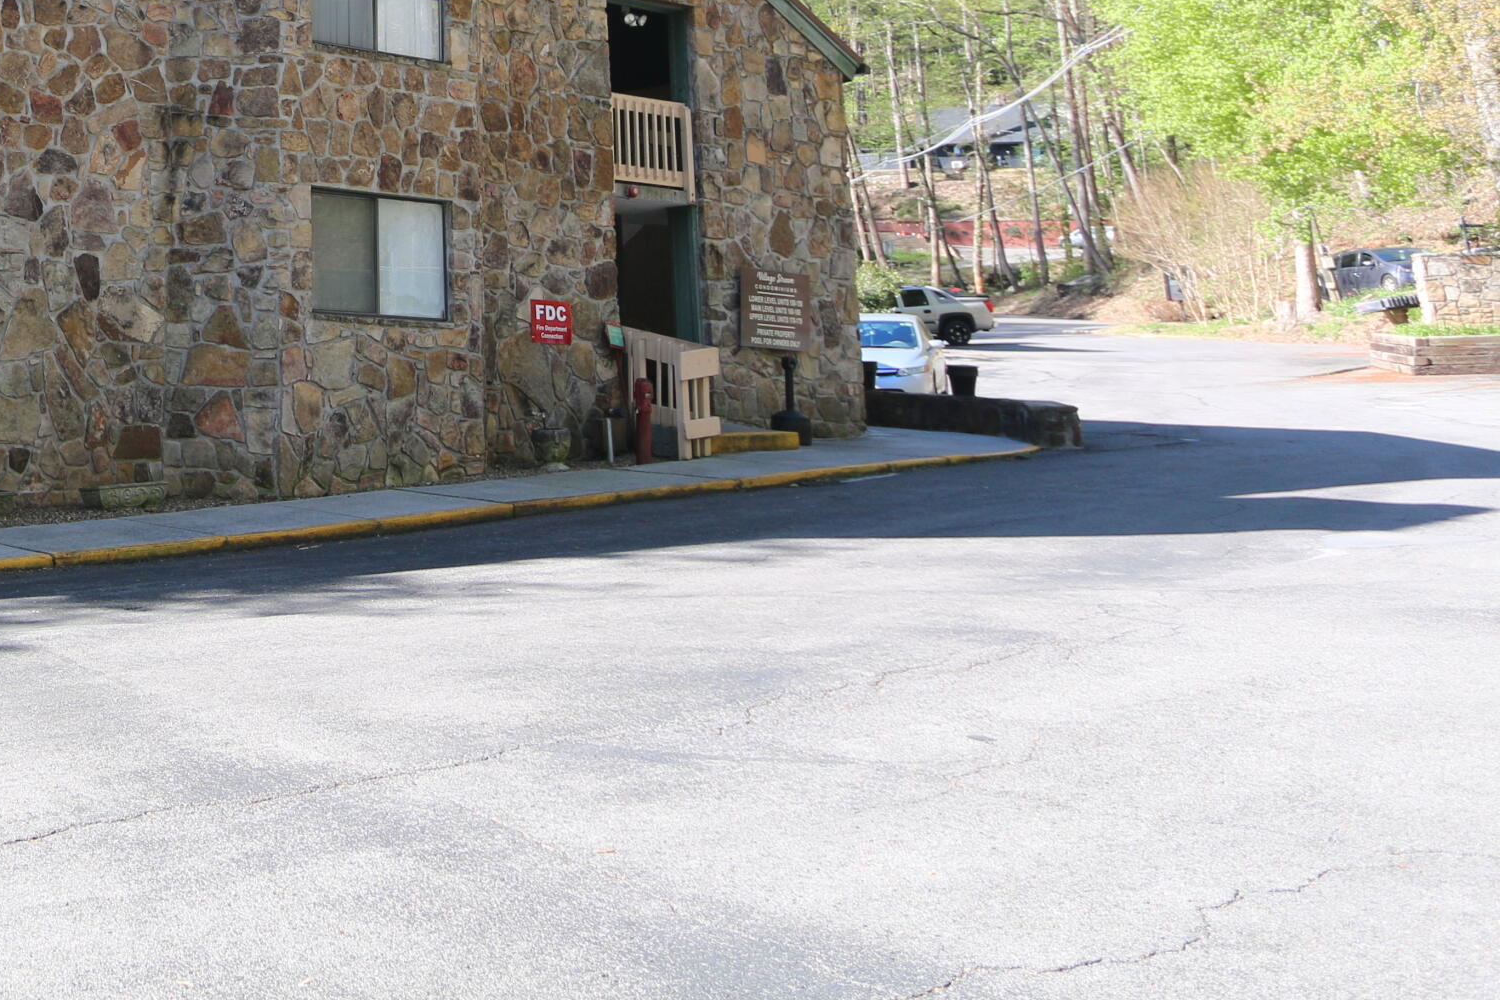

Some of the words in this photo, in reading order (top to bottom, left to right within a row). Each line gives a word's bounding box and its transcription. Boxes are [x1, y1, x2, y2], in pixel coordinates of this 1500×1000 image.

[757, 271, 776, 285] Village
[749, 295, 764, 303] LOWER
[764, 296, 777, 304] LEVEL
[535, 304, 567, 322] FDC
[751, 304, 762, 312] MAIN
[762, 305, 774, 313] LEVEL
[763, 314, 776, 322] LEVEL
[545, 324, 567, 333] Department
[757, 328, 774, 337] PRIVATE
[774, 329, 796, 339] PROPERTY
[751, 336, 763, 345] POOL
[763, 337, 772, 345] FOR
